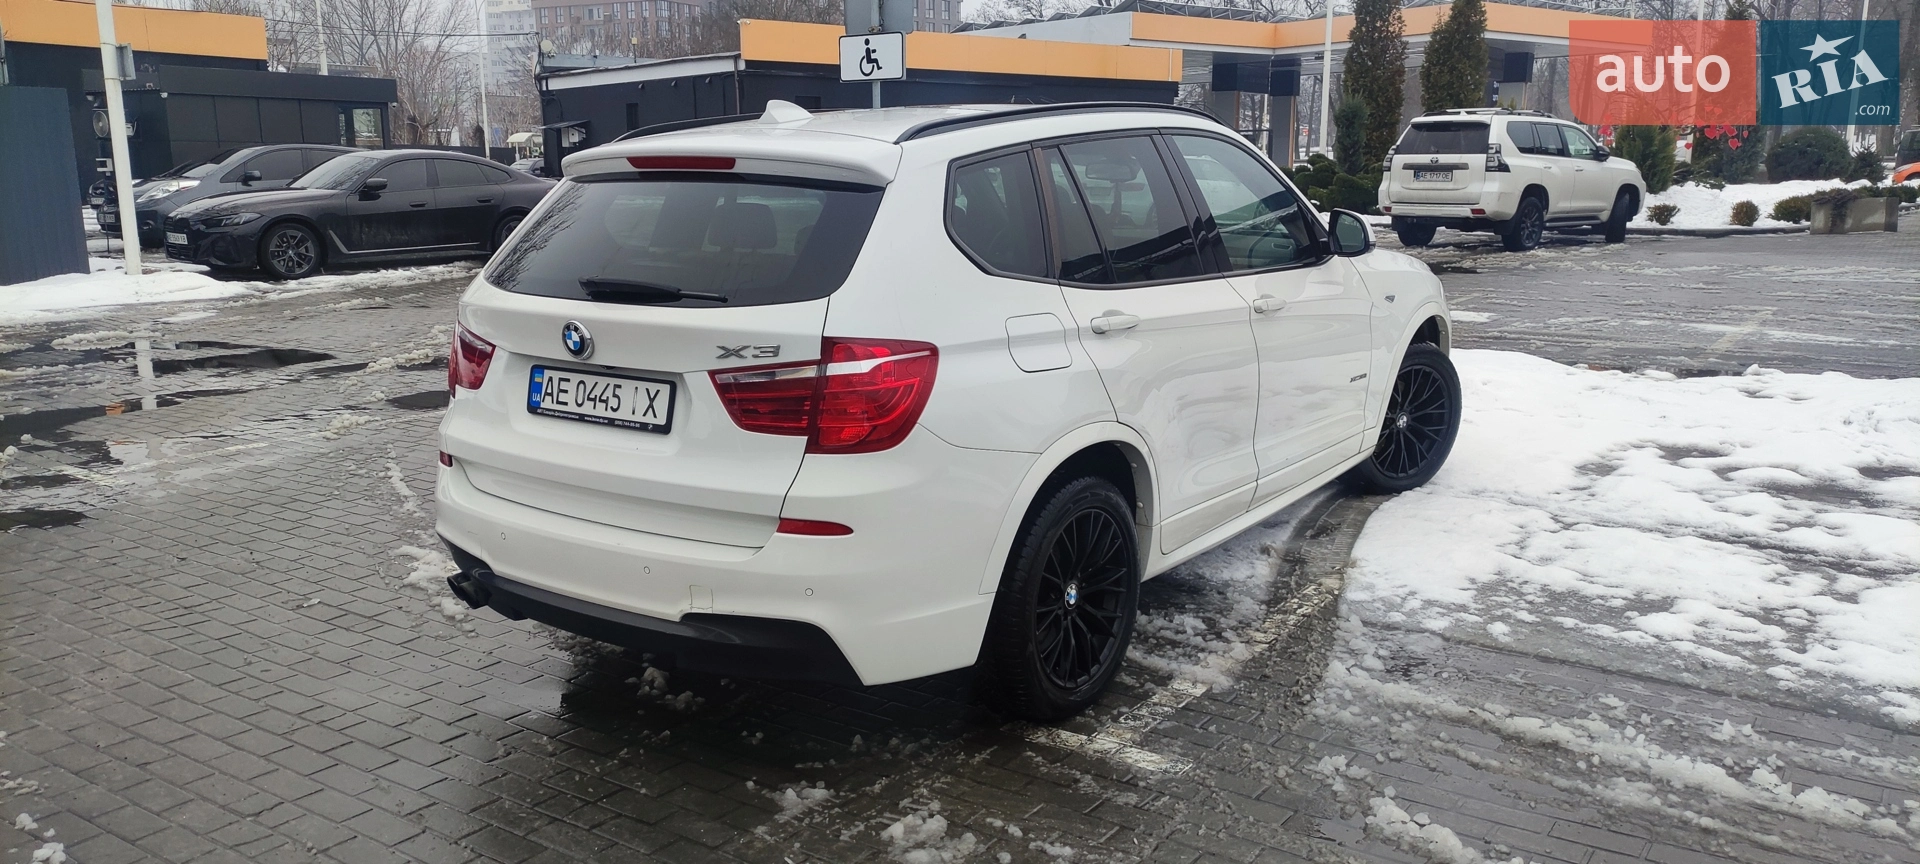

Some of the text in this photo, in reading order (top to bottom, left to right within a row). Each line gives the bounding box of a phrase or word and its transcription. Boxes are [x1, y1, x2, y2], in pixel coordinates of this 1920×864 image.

[715, 344, 781, 360] X3
[532, 392, 541, 402] UA
[542, 376, 571, 406] AE
[574, 379, 622, 412] 0445
